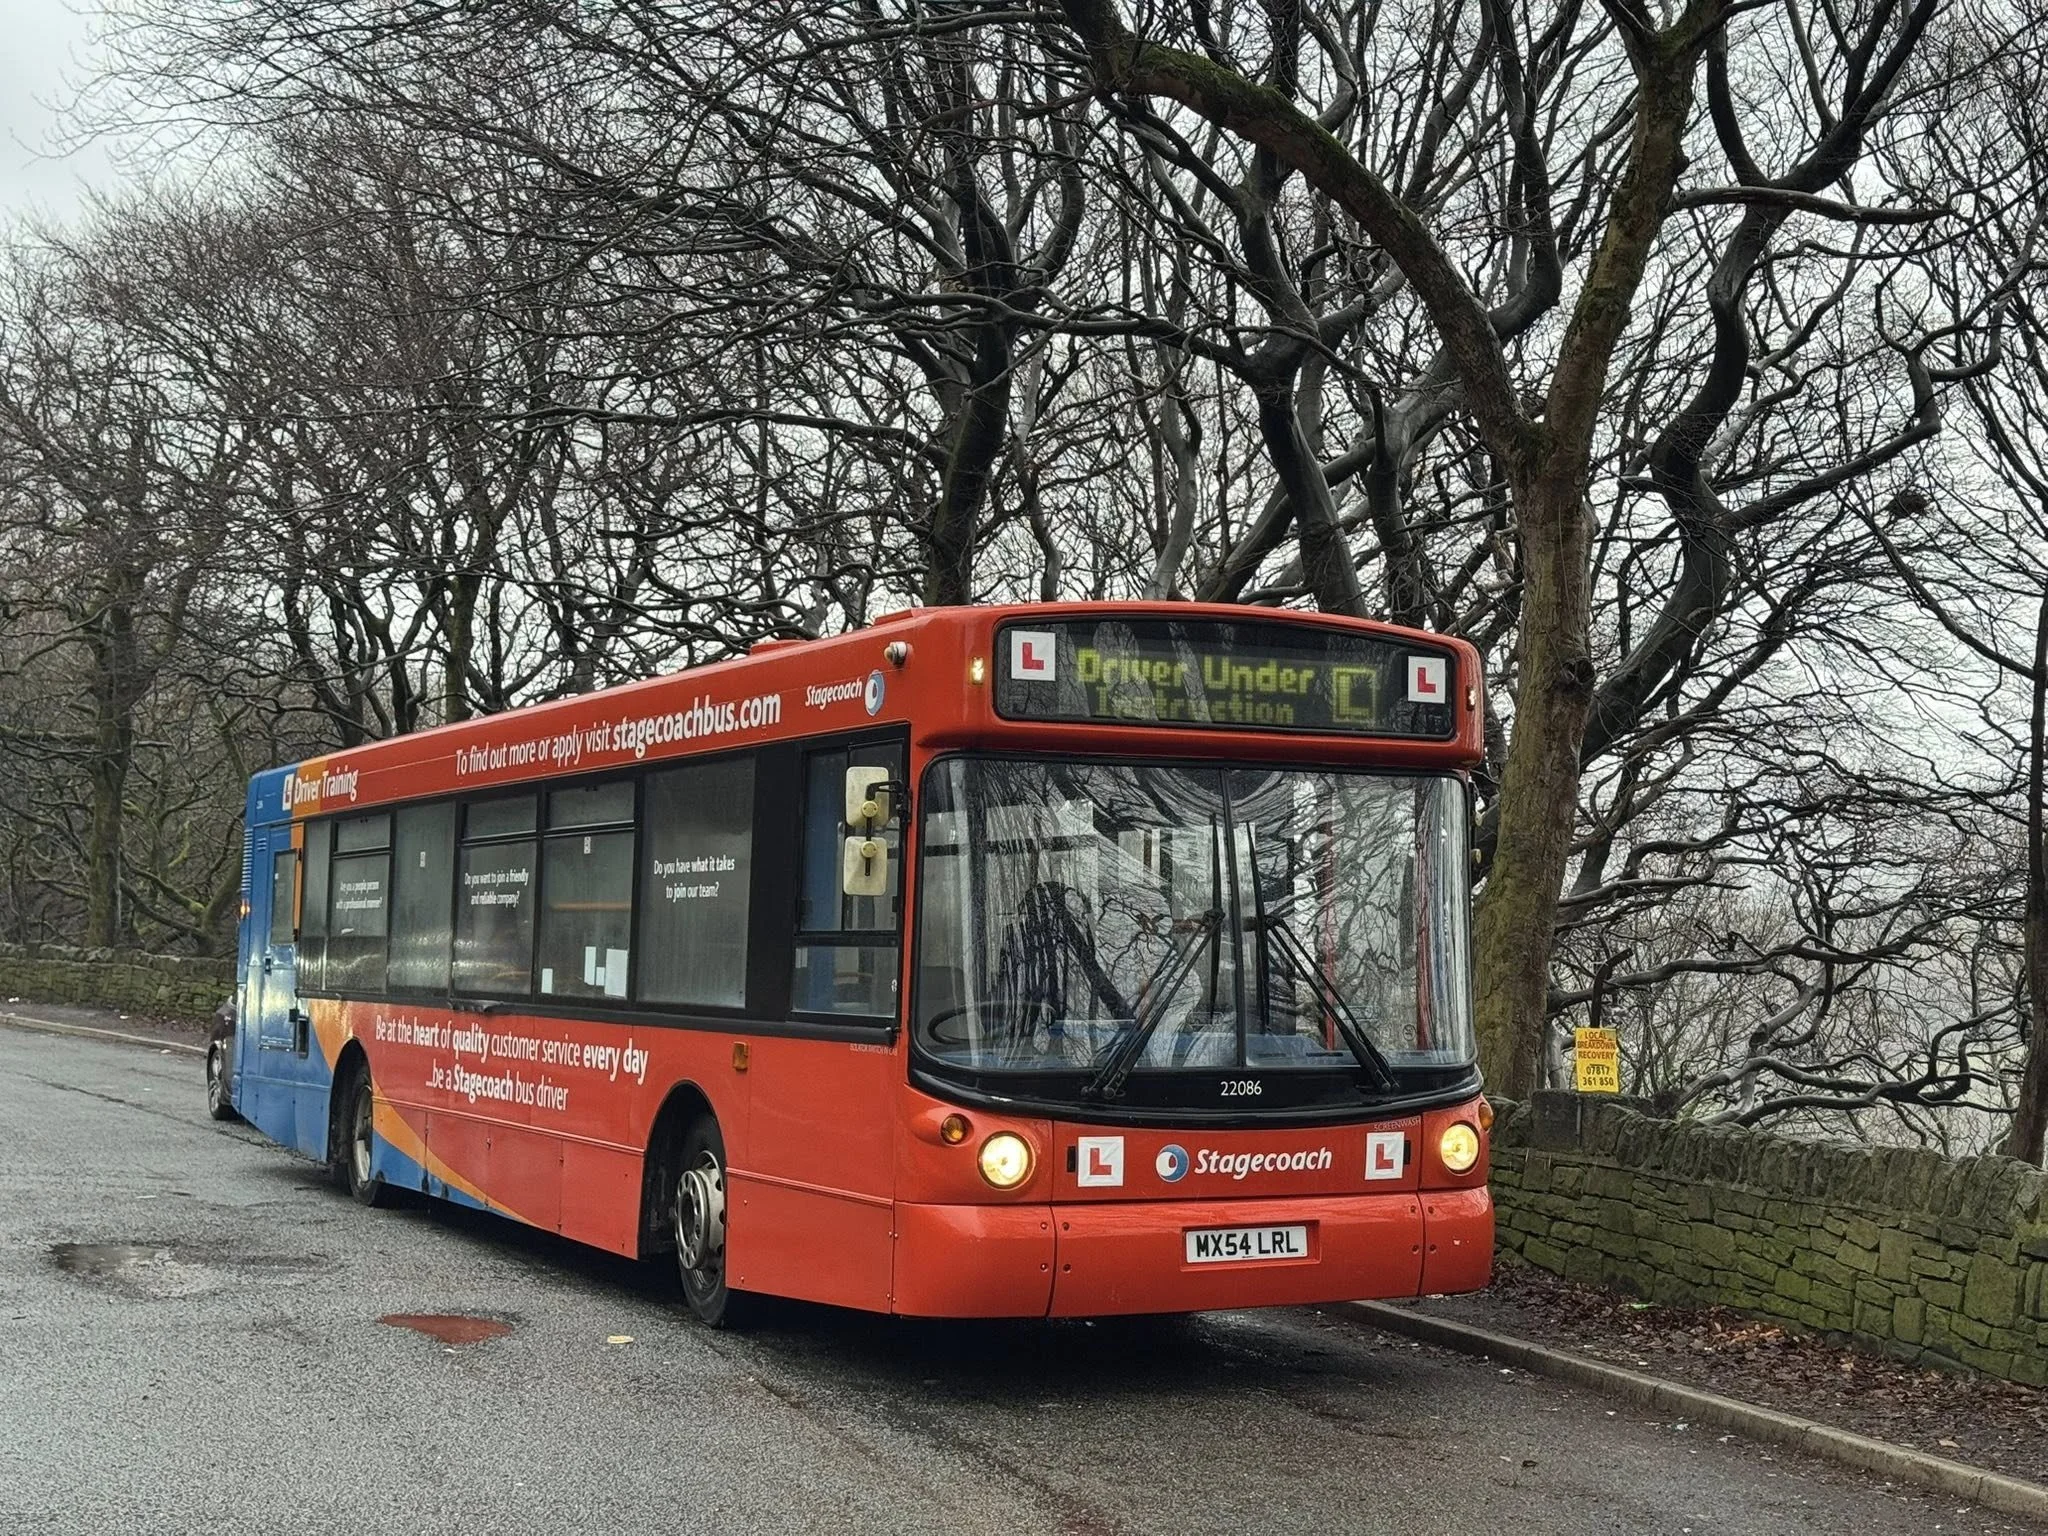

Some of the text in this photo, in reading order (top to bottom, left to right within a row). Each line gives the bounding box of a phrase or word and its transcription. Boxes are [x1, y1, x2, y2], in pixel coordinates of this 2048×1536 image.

[1022, 642, 1045, 671] L
[1078, 649, 1316, 694] Driver Under
[1417, 667, 1436, 693] L
[805, 678, 862, 710] Stagecoach
[456, 693, 781, 776] To find out more or apply visit stagecoachbus.com
[294, 765, 360, 805] Driver Training
[509, 867, 529, 886] friendly
[654, 854, 735, 879] Do you have what it takes
[497, 890, 520, 908] company?
[666, 881, 720, 903] to join our team?
[1577, 1040, 1616, 1050] BREAKDOWN
[1584, 1031, 1607, 1040] LOCAL
[375, 1015, 649, 1086] Be at the heart of quality customer service every day
[1578, 1050, 1615, 1060] RECOVERY
[1582, 1076, 1614, 1087] 361 850
[1586, 1065, 1610, 1075] 07817
[446, 1069, 452, 1090] a
[453, 1063, 513, 1104] Stagecoach
[515, 1070, 535, 1106] bus
[536, 1074, 569, 1111] driver
[1220, 1080, 1262, 1096] 22086
[1373, 1115, 1421, 1131] SCREENWASH
[1090, 1147, 1112, 1175] L
[1194, 1146, 1333, 1180] Stagecoach
[1375, 1143, 1394, 1170] L
[1196, 1230, 1299, 1257] MX54 LRL
